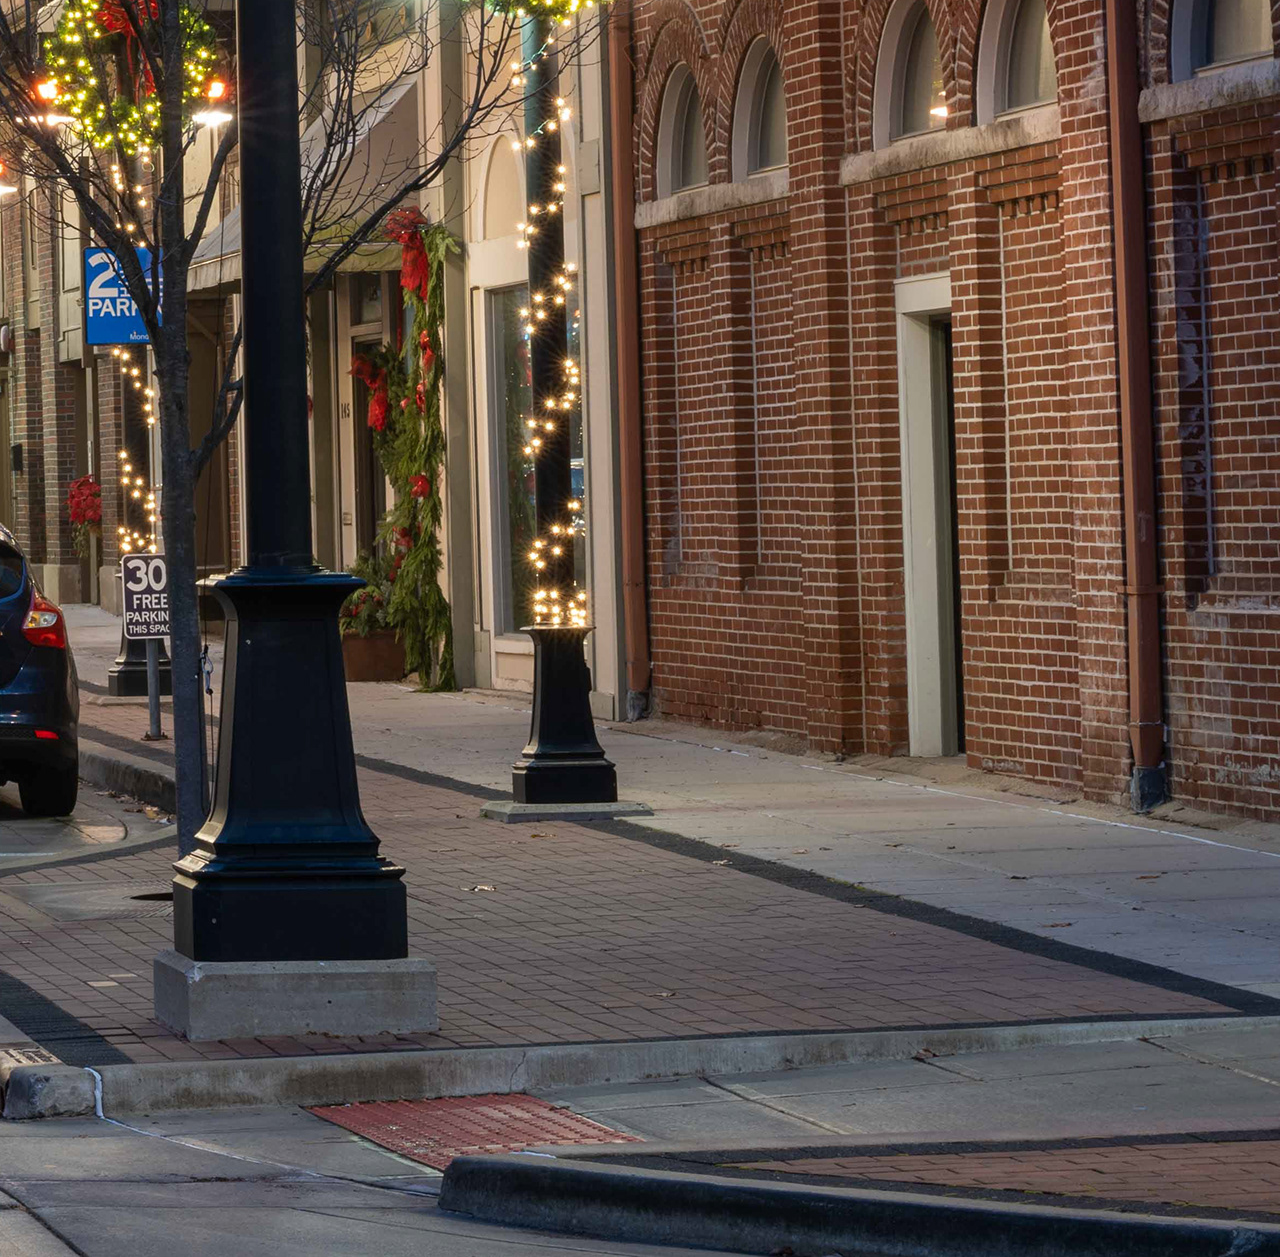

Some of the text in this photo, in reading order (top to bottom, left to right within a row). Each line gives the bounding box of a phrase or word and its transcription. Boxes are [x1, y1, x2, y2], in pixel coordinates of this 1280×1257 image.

[88, 252, 118, 298] 2
[126, 558, 167, 592] 30
[133, 593, 169, 609] FREE
[126, 610, 169, 623] PARKIN
[128, 624, 170, 634] THIS SPAC
